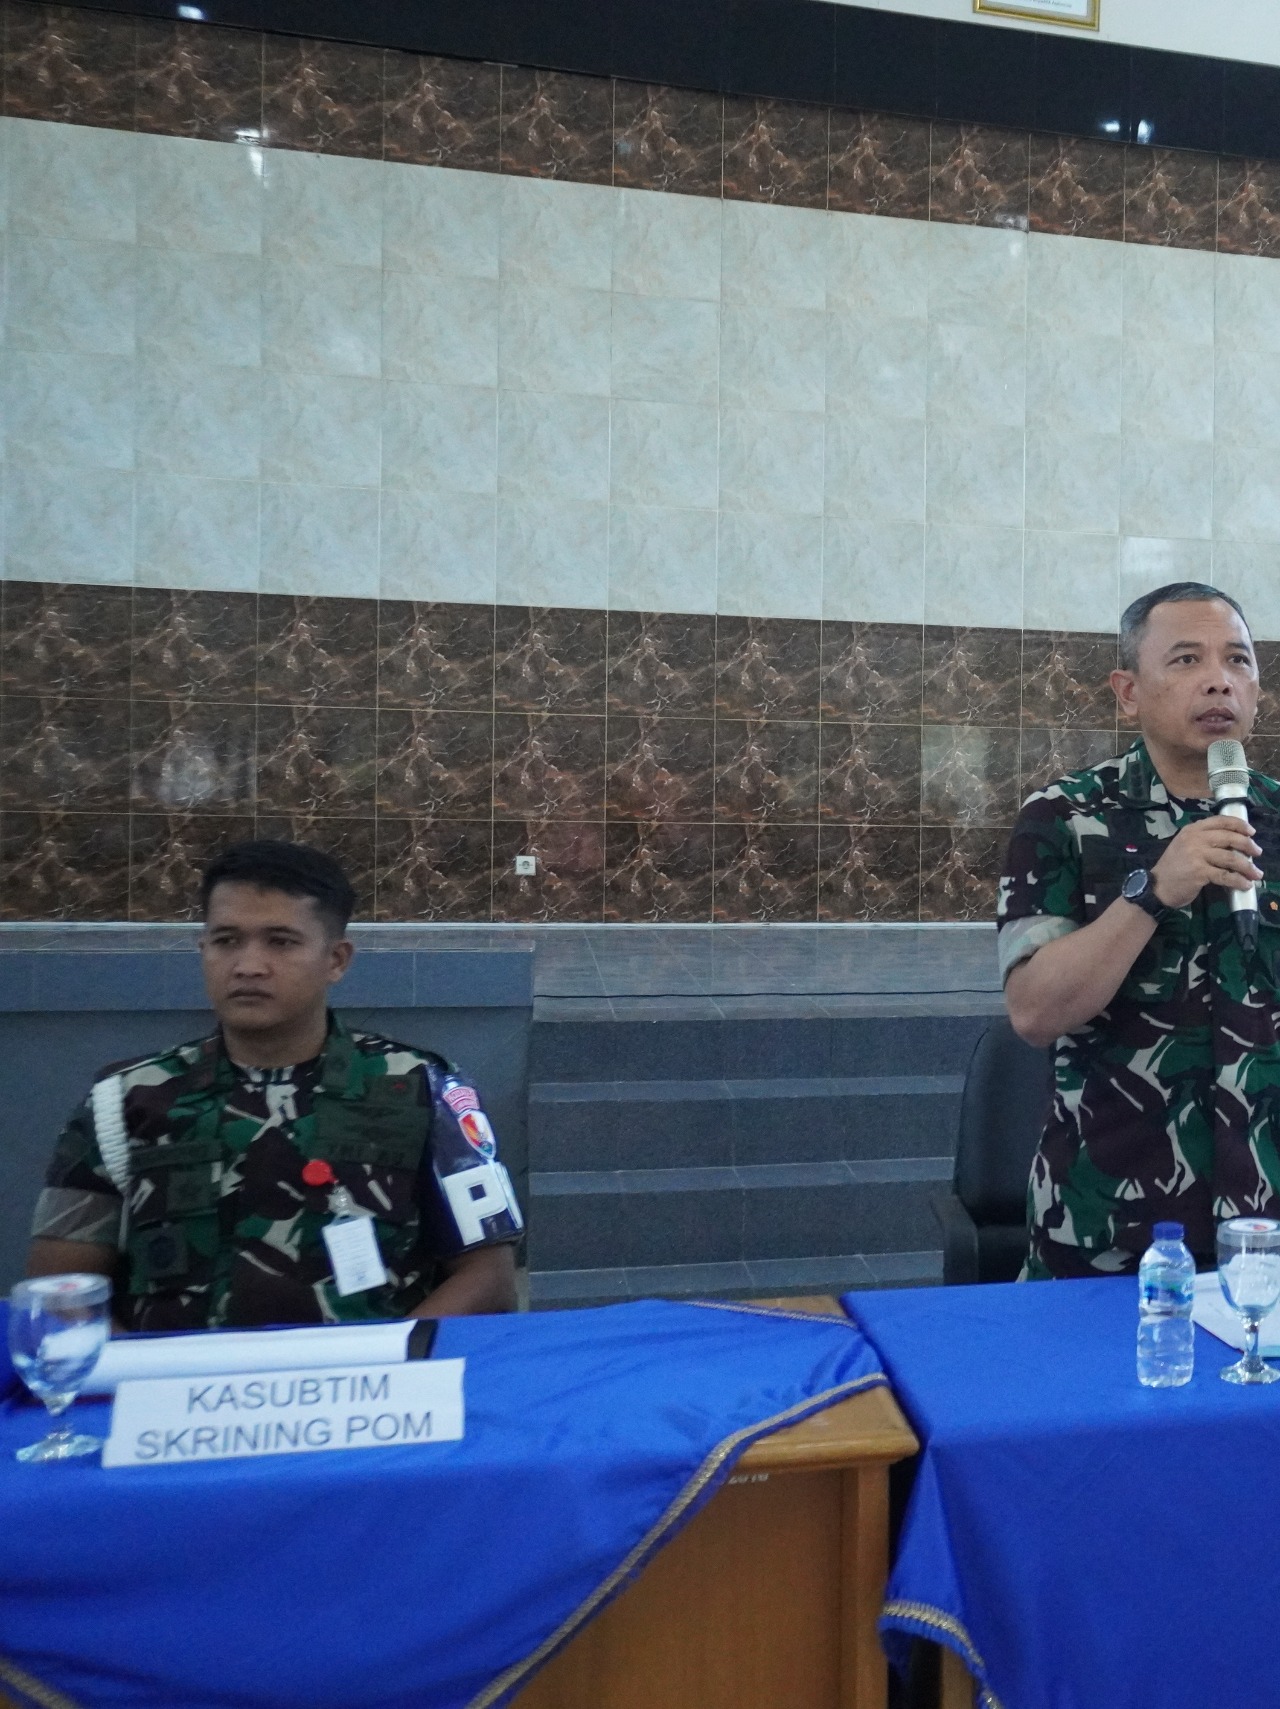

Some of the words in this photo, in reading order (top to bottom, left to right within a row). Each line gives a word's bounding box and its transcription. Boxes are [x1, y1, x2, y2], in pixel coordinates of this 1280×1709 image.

[187, 1373, 390, 1414] KASUBTIM
[134, 1417, 332, 1460] SKRINING
[345, 1411, 433, 1443] POM
